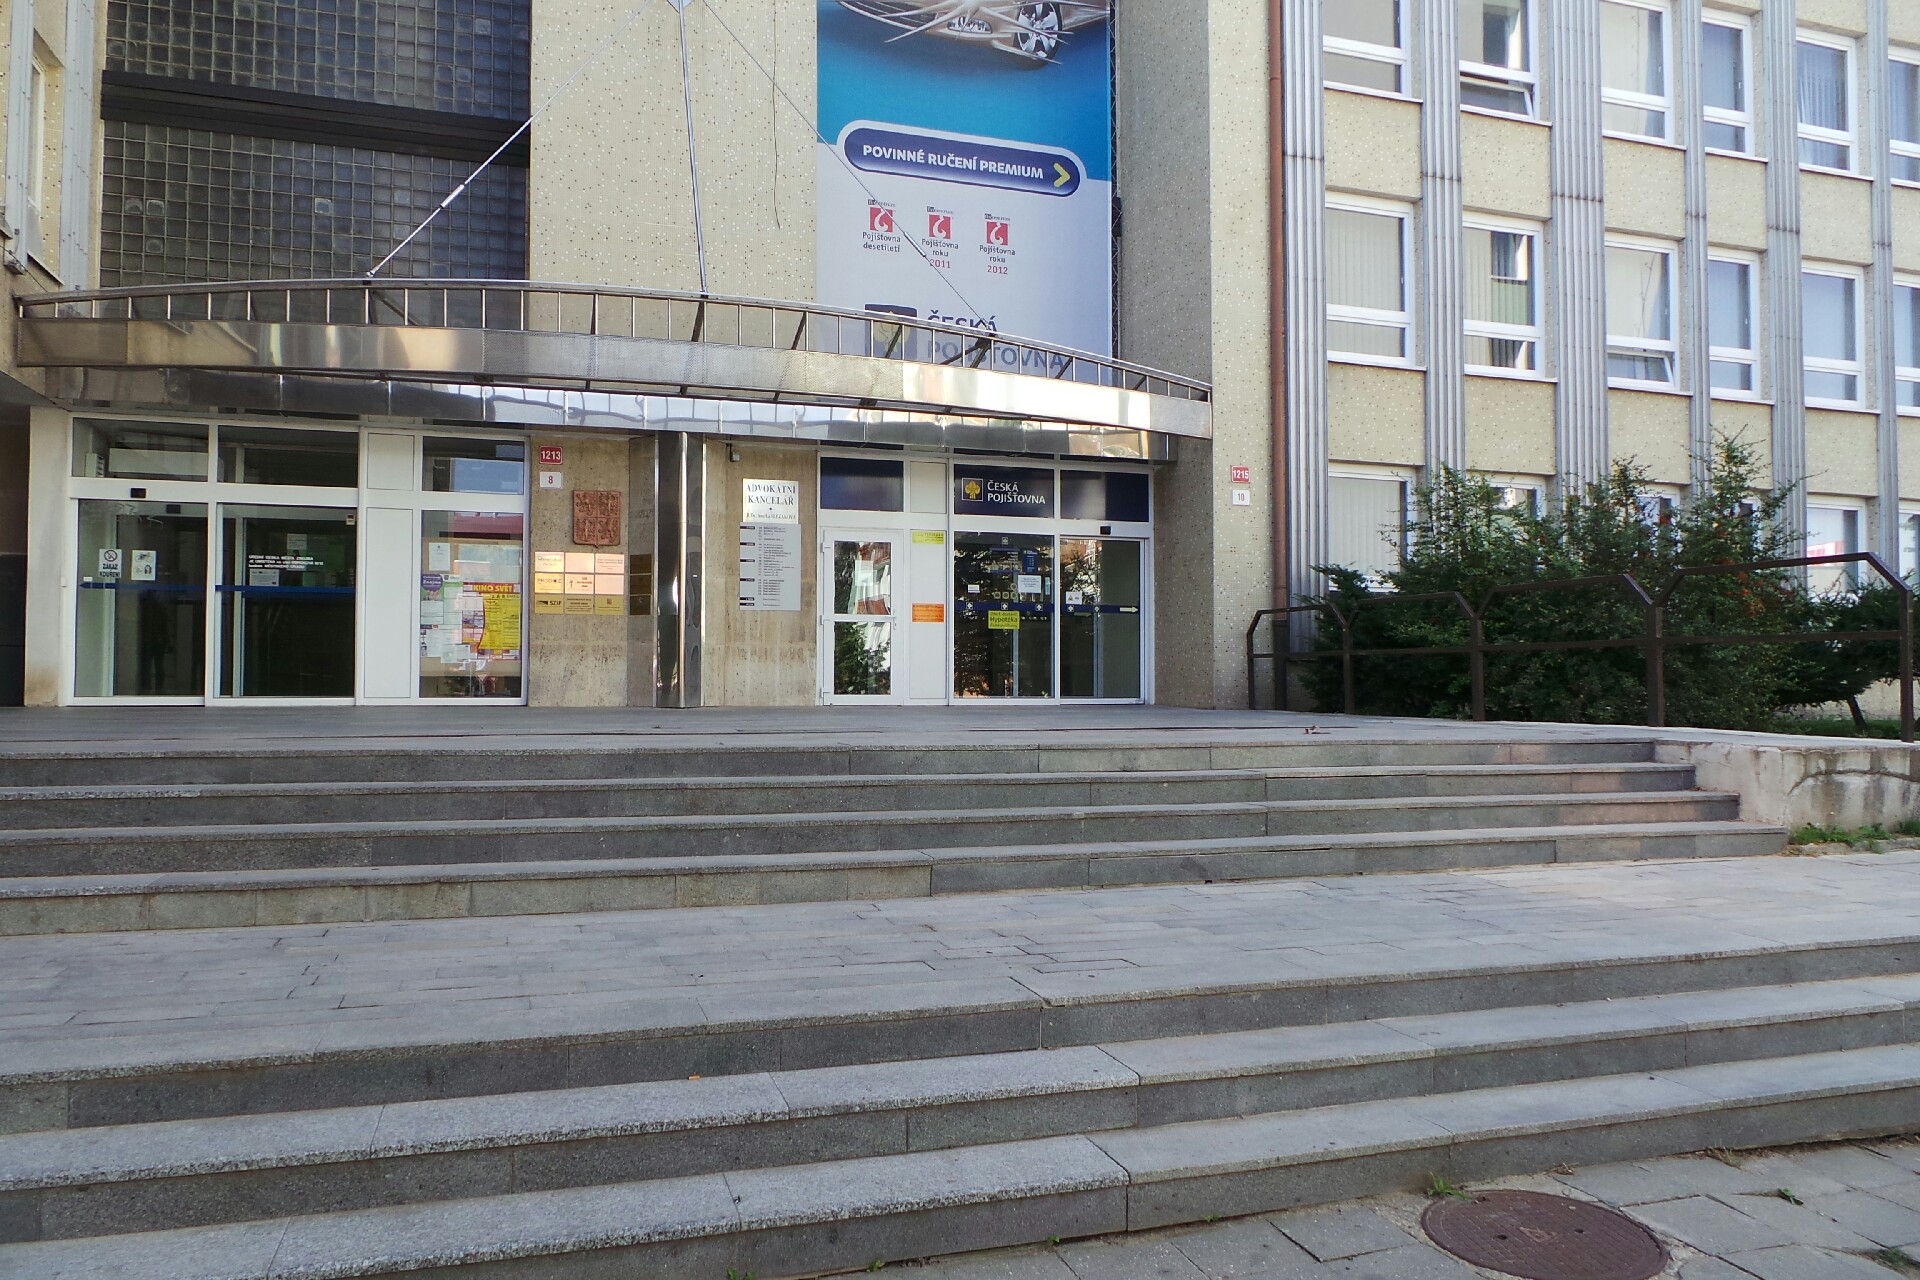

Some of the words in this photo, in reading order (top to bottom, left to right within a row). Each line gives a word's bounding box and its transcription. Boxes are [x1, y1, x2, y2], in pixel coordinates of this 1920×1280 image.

[863, 144, 924, 163] POVINNÉ
[928, 153, 977, 170] RUČENÍ
[980, 160, 1044, 179] PREMIUM
[930, 259, 951, 269] 2011
[987, 265, 1008, 275] 2012
[541, 451, 561, 460] 1213
[1233, 470, 1249, 479] 1215
[548, 476, 553, 484] 8
[988, 480, 1018, 492] ČESKÁ
[988, 492, 1045, 504] POJIŠŤOVNA
[1238, 493, 1244, 501] 10
[495, 584, 512, 592] SVĚT
